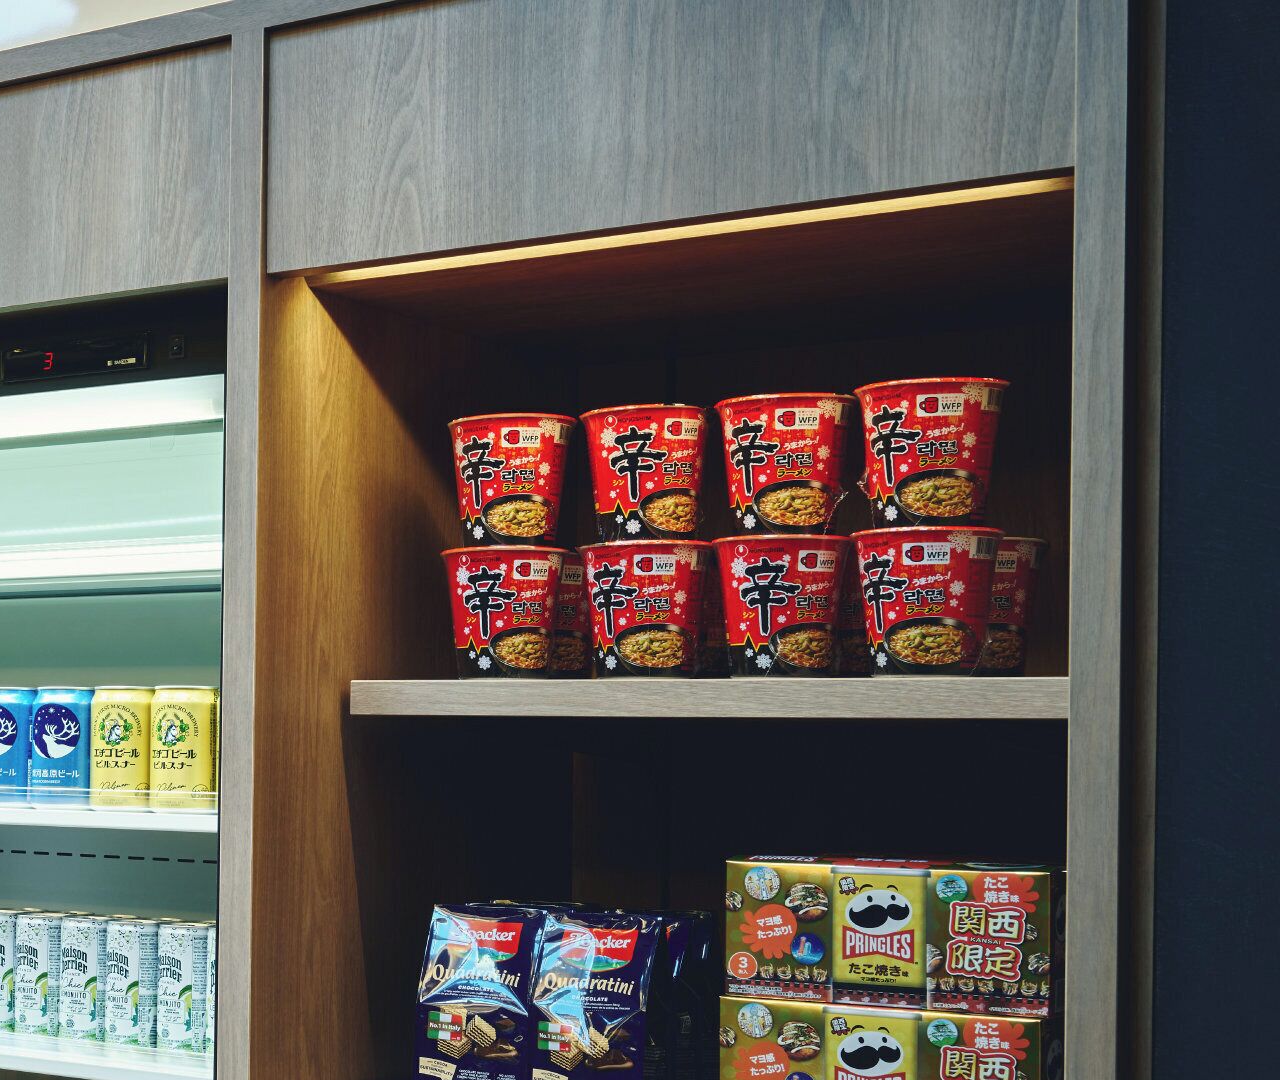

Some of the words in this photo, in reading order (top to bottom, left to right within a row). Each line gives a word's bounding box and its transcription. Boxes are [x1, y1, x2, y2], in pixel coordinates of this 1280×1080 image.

[43, 352, 53, 370] 3
[870, 405, 921, 486] 辛
[916, 441, 958, 455] 라면
[731, 418, 780, 496] 辛
[775, 452, 813, 467] 라면
[919, 456, 956, 467] ラーメン
[610, 426, 668, 502] 辛
[663, 462, 693, 474] 라면
[461, 436, 506, 508] 辛
[501, 469, 535, 482] 라면
[777, 468, 812, 478] ラーメン
[665, 475, 690, 485] ラーメン
[503, 483, 533, 491] ラーメン
[740, 557, 801, 636] 辛
[863, 552, 909, 634] 辛
[903, 589, 945, 604] 라면
[463, 565, 517, 639] 辛
[593, 563, 638, 638] 辛
[634, 598, 670, 610] 라면
[795, 595, 828, 608] 라면
[512, 602, 542, 614] 라면
[513, 616, 541, 624] ラーメン
[94, 748, 140, 758] エチゴビール
[152, 749, 197, 759] エチゴビール
[984, 877, 1009, 888] たこ
[984, 891, 1019, 903] 焼き味
[756, 915, 783, 926] マヨ感
[955, 906, 1021, 939] 関西
[757, 926, 793, 939] たっぷり!
[845, 930, 911, 959] PRINGLES
[970, 937, 1001, 945] KANSAI
[739, 957, 747, 967] 3
[952, 943, 1016, 976] 限定
[848, 963, 909, 977] たこ焼き味
[545, 973, 634, 995] Quadratini
[449, 1024, 461, 1032] Italy
[975, 1022, 999, 1035] たこ
[539, 1032, 550, 1040] No.1
[557, 1035, 570, 1043] Italy
[975, 1037, 1010, 1049] 焼き味
[749, 1052, 776, 1064] マヨ感
[750, 1063, 785, 1076] たっぷり!
